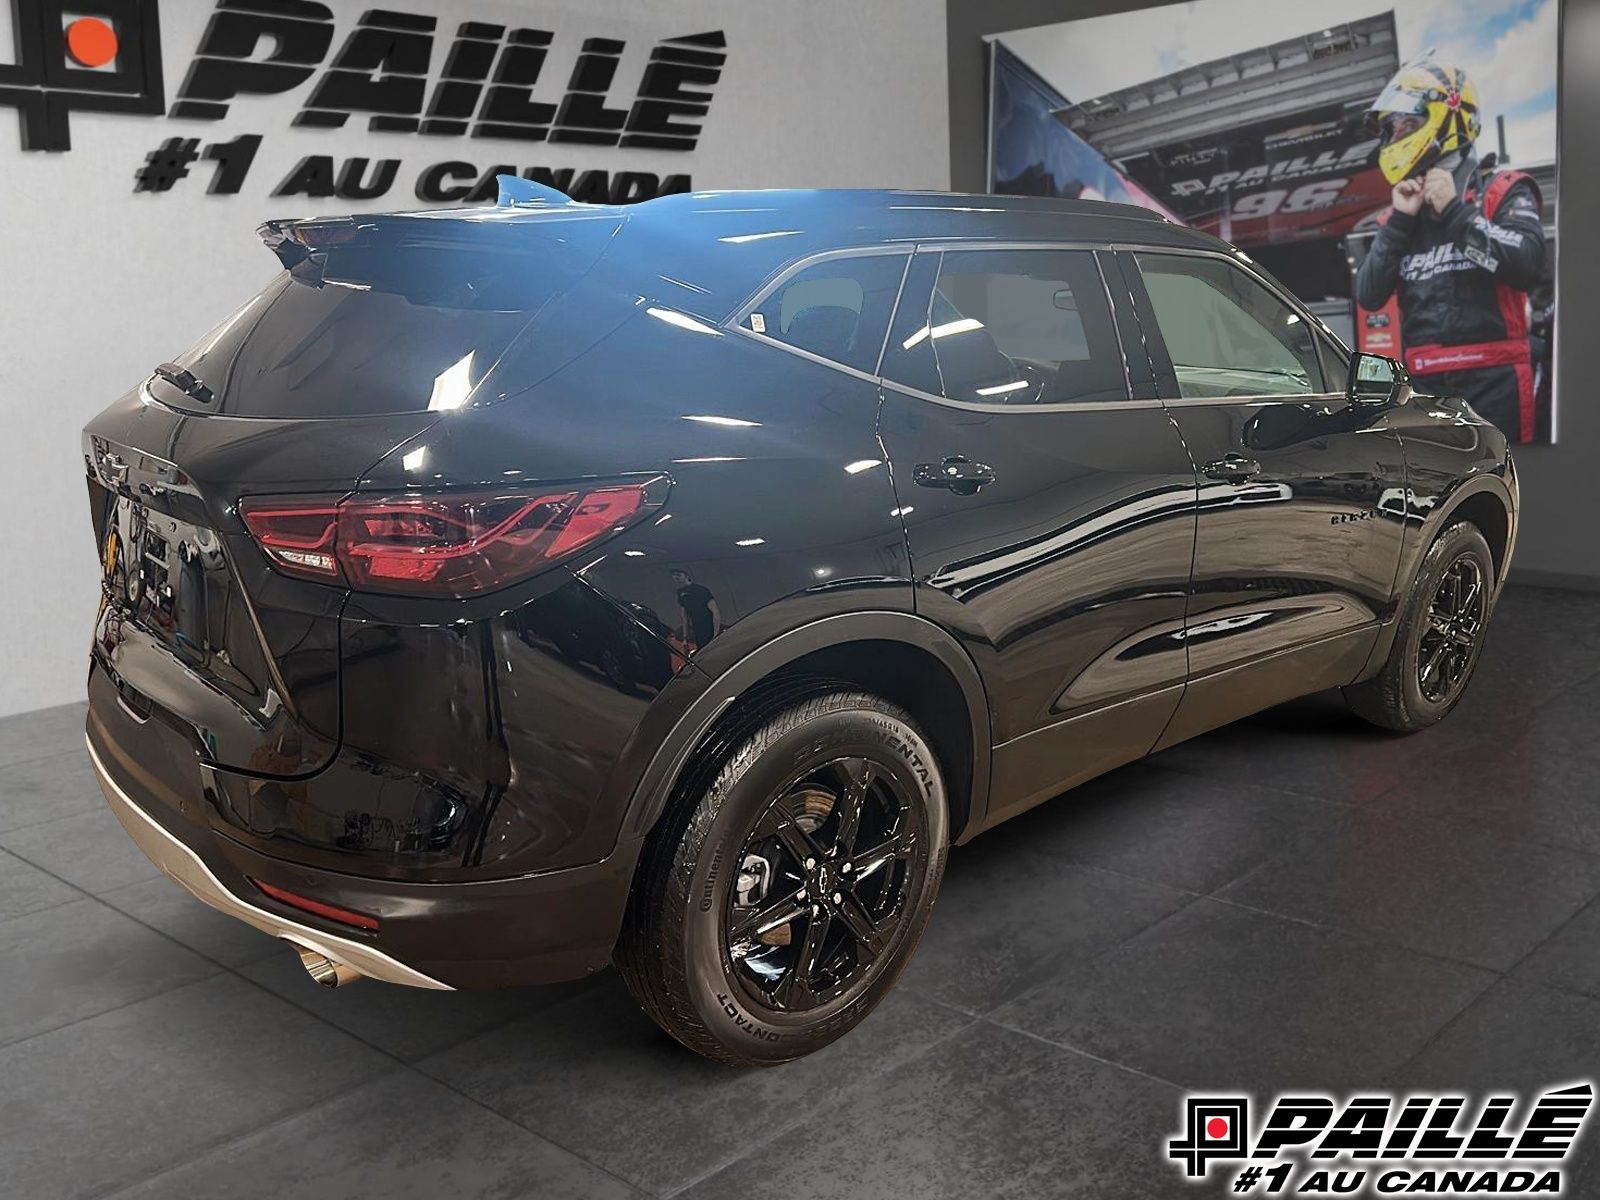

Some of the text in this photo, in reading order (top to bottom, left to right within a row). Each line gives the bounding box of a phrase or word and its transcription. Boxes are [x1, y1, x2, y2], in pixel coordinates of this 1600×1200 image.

[166, 0, 727, 151] PAILLÉ
[132, 134, 692, 205] #1 AU CANADA
[1230, 178, 1349, 222] 96
